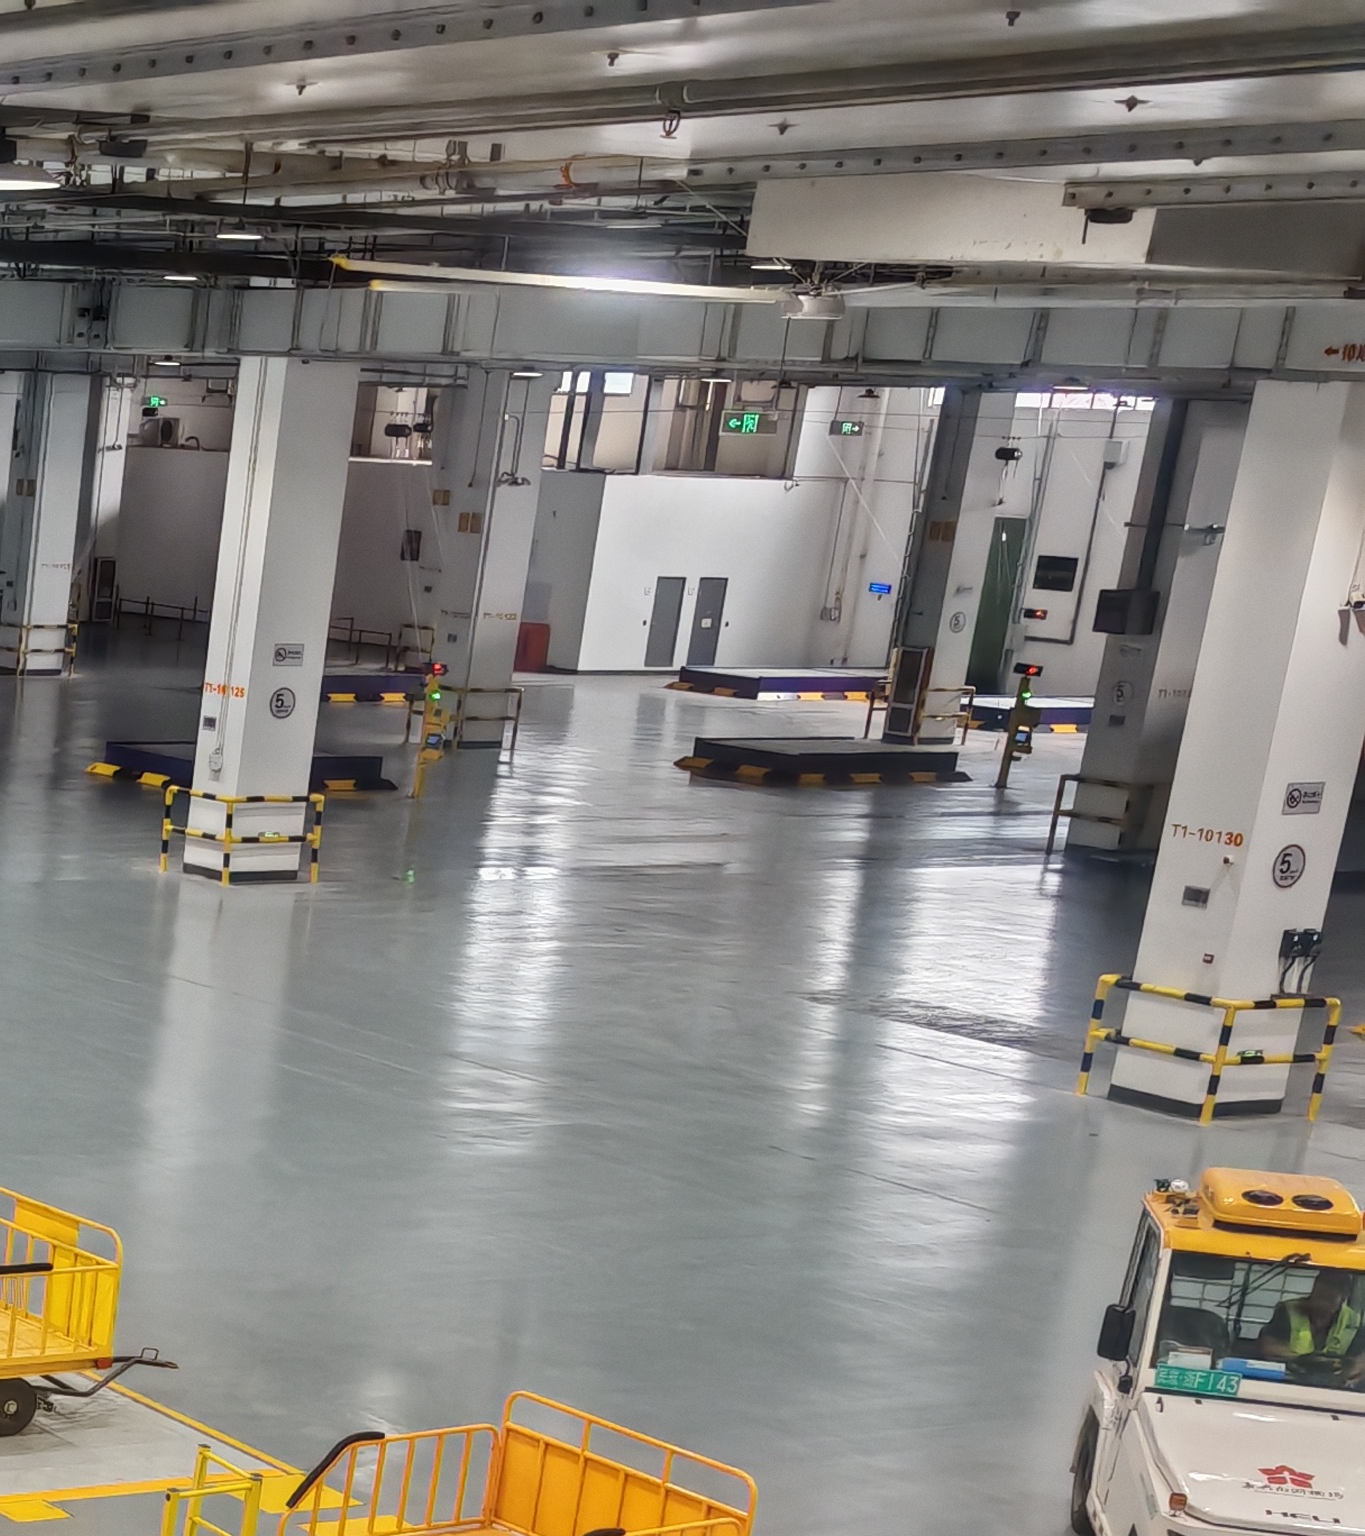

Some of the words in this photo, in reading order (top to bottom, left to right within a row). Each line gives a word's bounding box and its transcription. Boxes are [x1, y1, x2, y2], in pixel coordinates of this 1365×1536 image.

[275, 693, 284, 709] 5
[1171, 823, 1244, 847] T1-10130
[1279, 852, 1293, 875] 5
